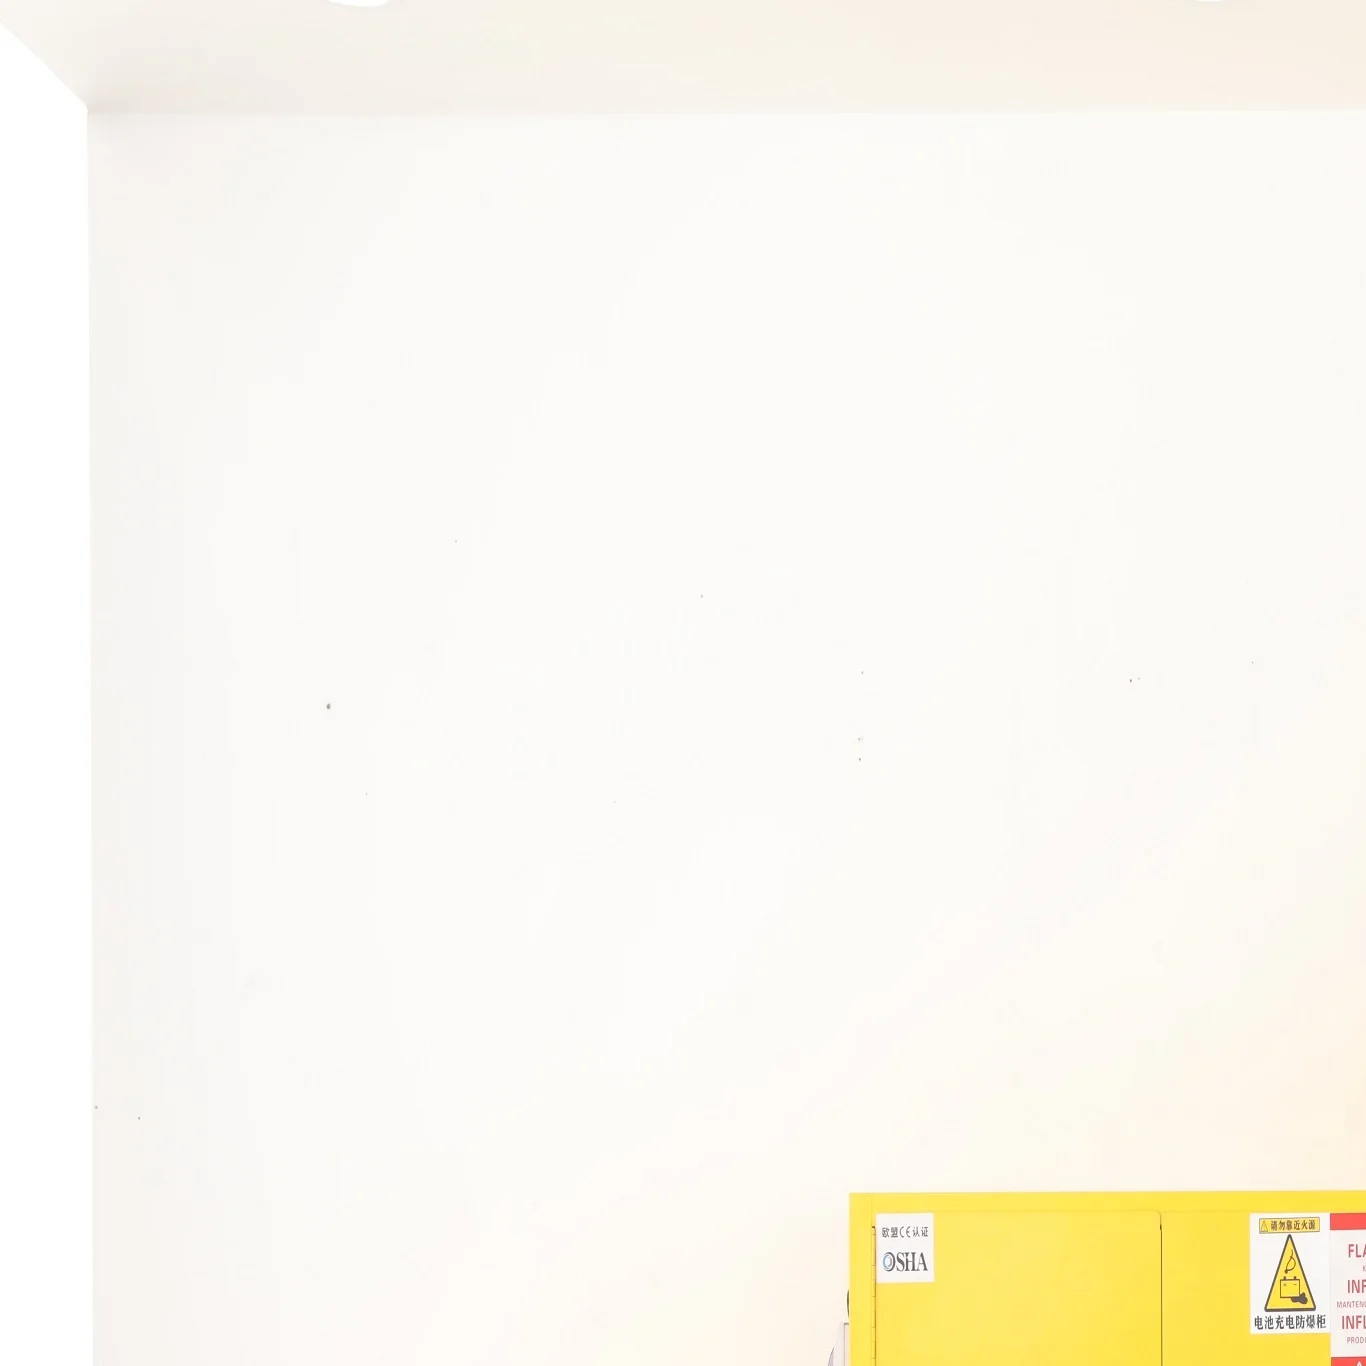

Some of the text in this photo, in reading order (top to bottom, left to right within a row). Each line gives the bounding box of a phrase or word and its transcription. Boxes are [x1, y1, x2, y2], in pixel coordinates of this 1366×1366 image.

[1271, 1220, 1316, 1230] 请勿靠近火源
[883, 1252, 928, 1272] OSHA
[1254, 1314, 1326, 1330] 电池充电防爆柜
